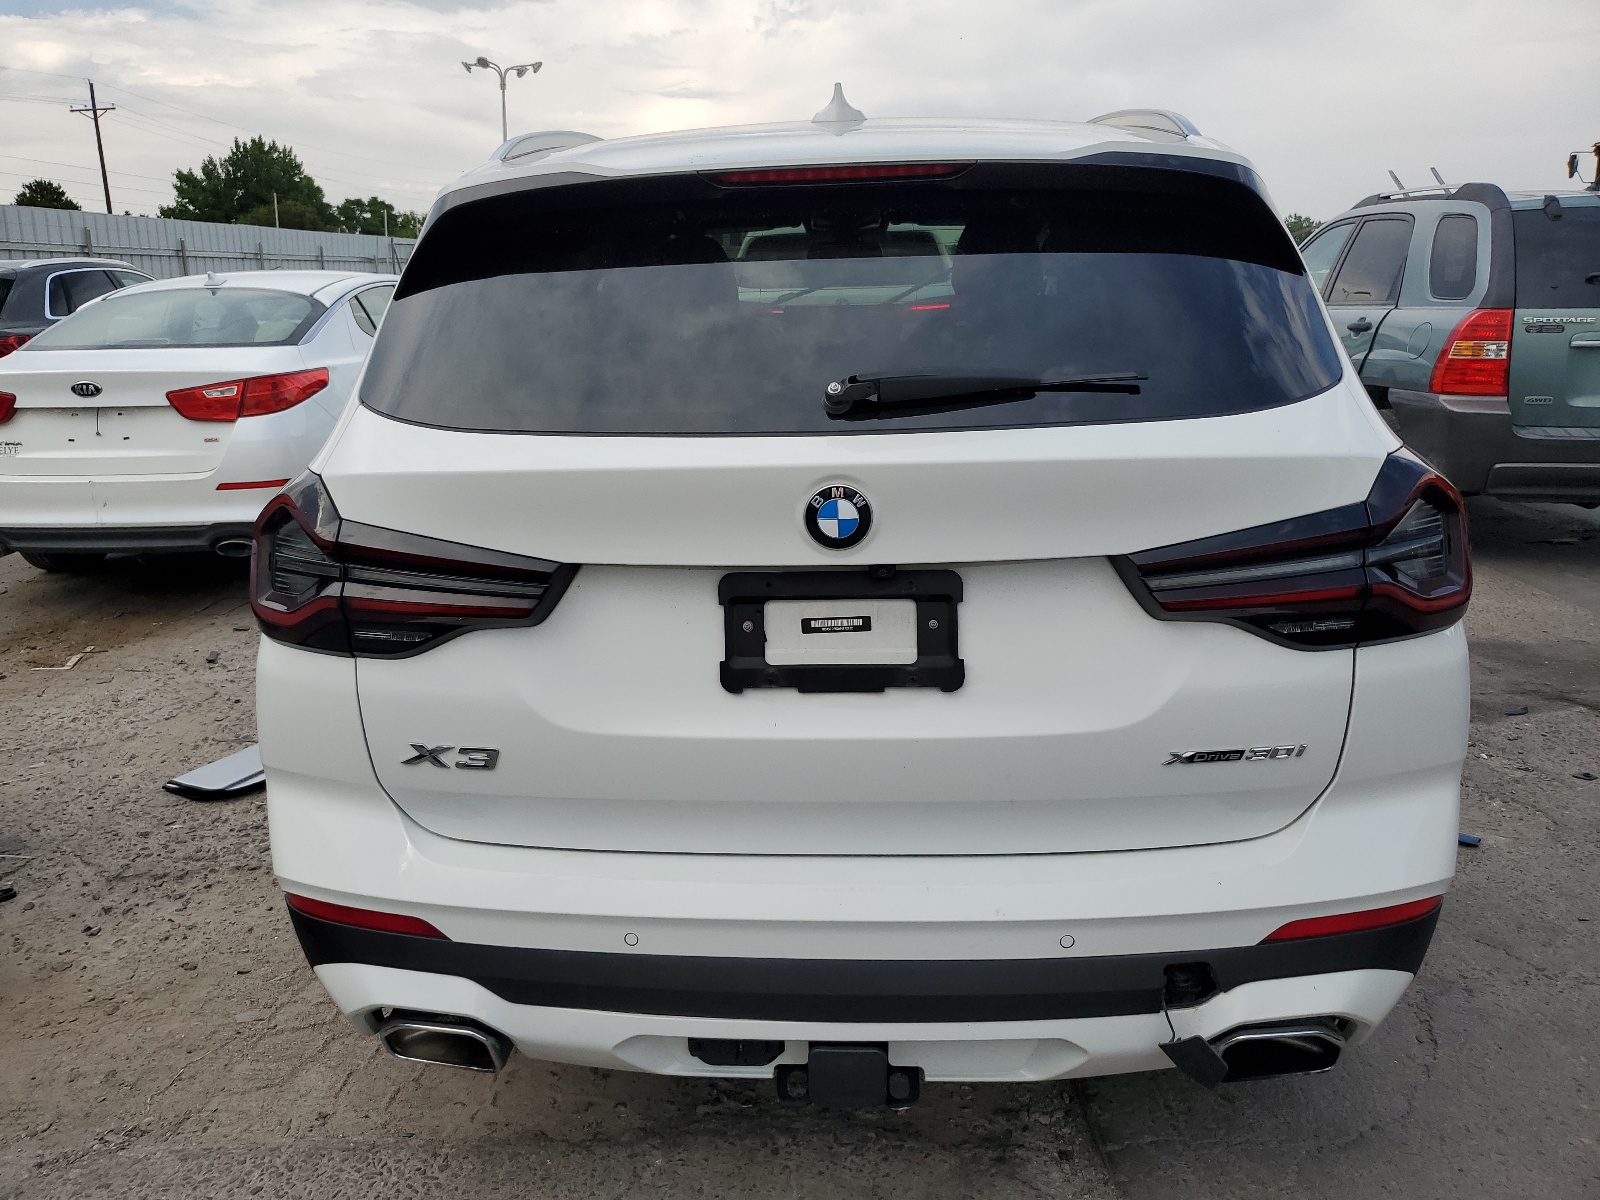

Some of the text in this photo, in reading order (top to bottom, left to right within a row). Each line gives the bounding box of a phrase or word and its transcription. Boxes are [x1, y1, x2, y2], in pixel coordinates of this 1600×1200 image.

[1522, 316, 1597, 324] SPORTAGE
[73, 383, 98, 396] KIA
[810, 486, 866, 508] BMW
[400, 742, 500, 770] X3
